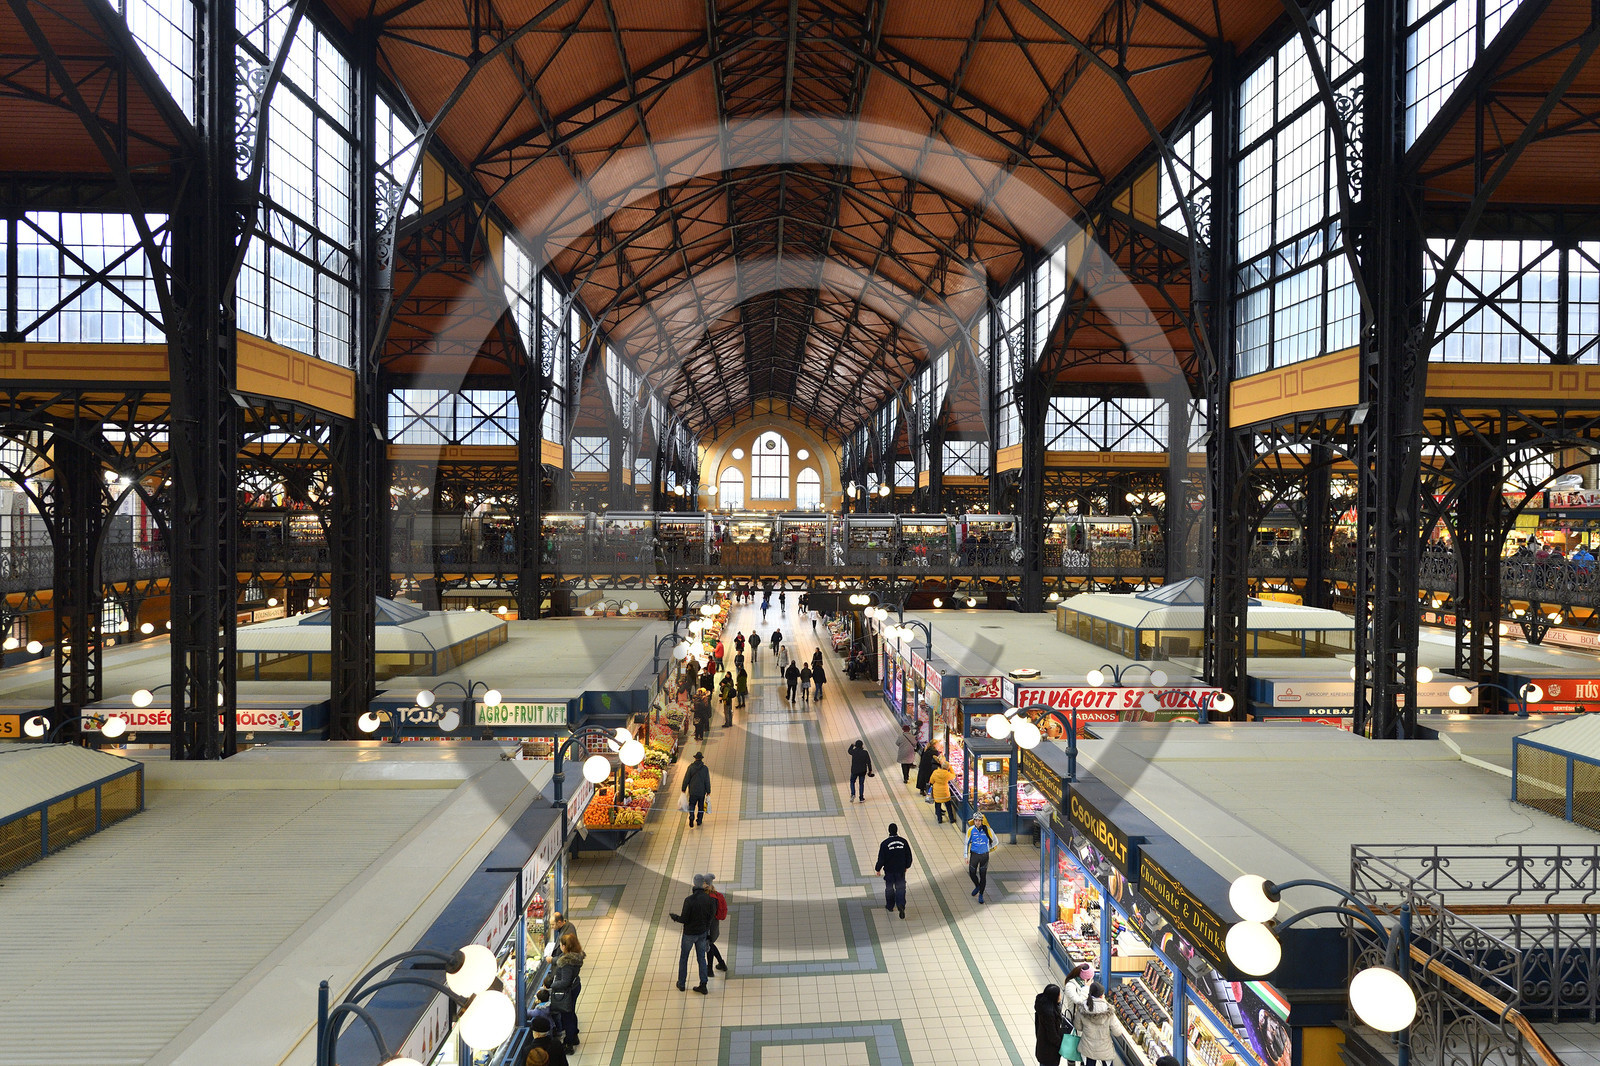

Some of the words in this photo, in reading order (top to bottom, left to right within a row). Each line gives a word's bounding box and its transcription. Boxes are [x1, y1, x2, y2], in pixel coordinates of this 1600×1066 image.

[1581, 635, 1597, 646] BOL
[1020, 689, 1117, 708] FELVÁGOTT
[1124, 689, 1219, 708] SZKÜZLET
[1575, 681, 1599, 699] HÚS
[479, 705, 544, 723] AGRO-FRUIT
[546, 706, 567, 723] KFT.
[0, 721, 12, 733] S
[1141, 864, 1180, 910] Chocolate
[1182, 903, 1190, 919] &
[1193, 911, 1226, 953] Drinks
